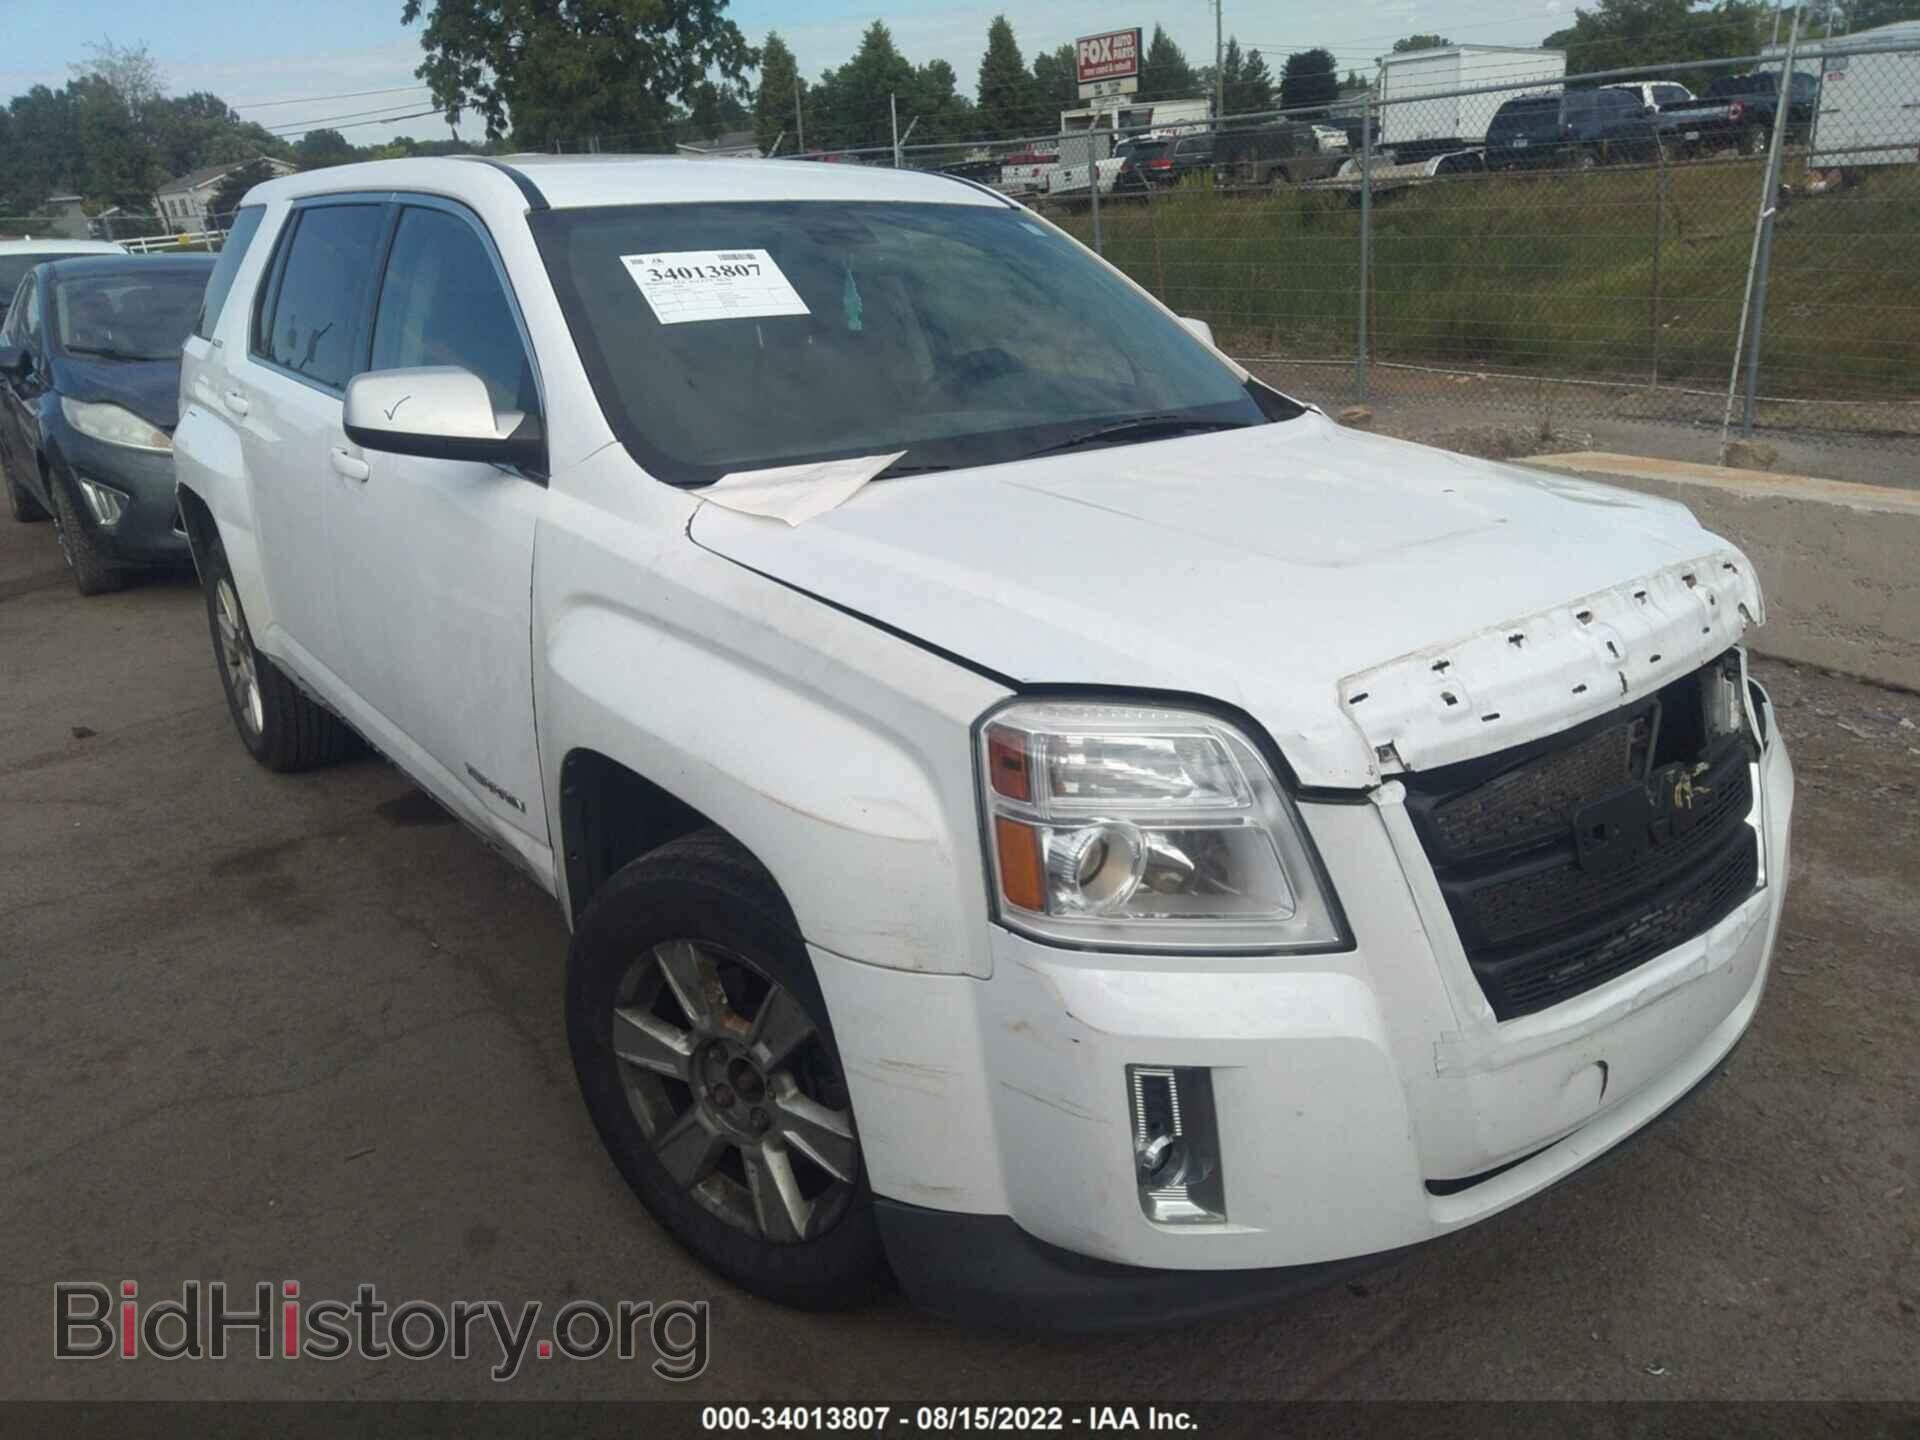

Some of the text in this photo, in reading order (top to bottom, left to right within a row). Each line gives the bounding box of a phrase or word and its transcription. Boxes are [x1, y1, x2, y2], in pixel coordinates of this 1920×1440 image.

[1112, 34, 1133, 48] AUTO
[1080, 37, 1112, 66] FOX
[1113, 46, 1136, 60] PARTS
[647, 263, 760, 282] 34013807
